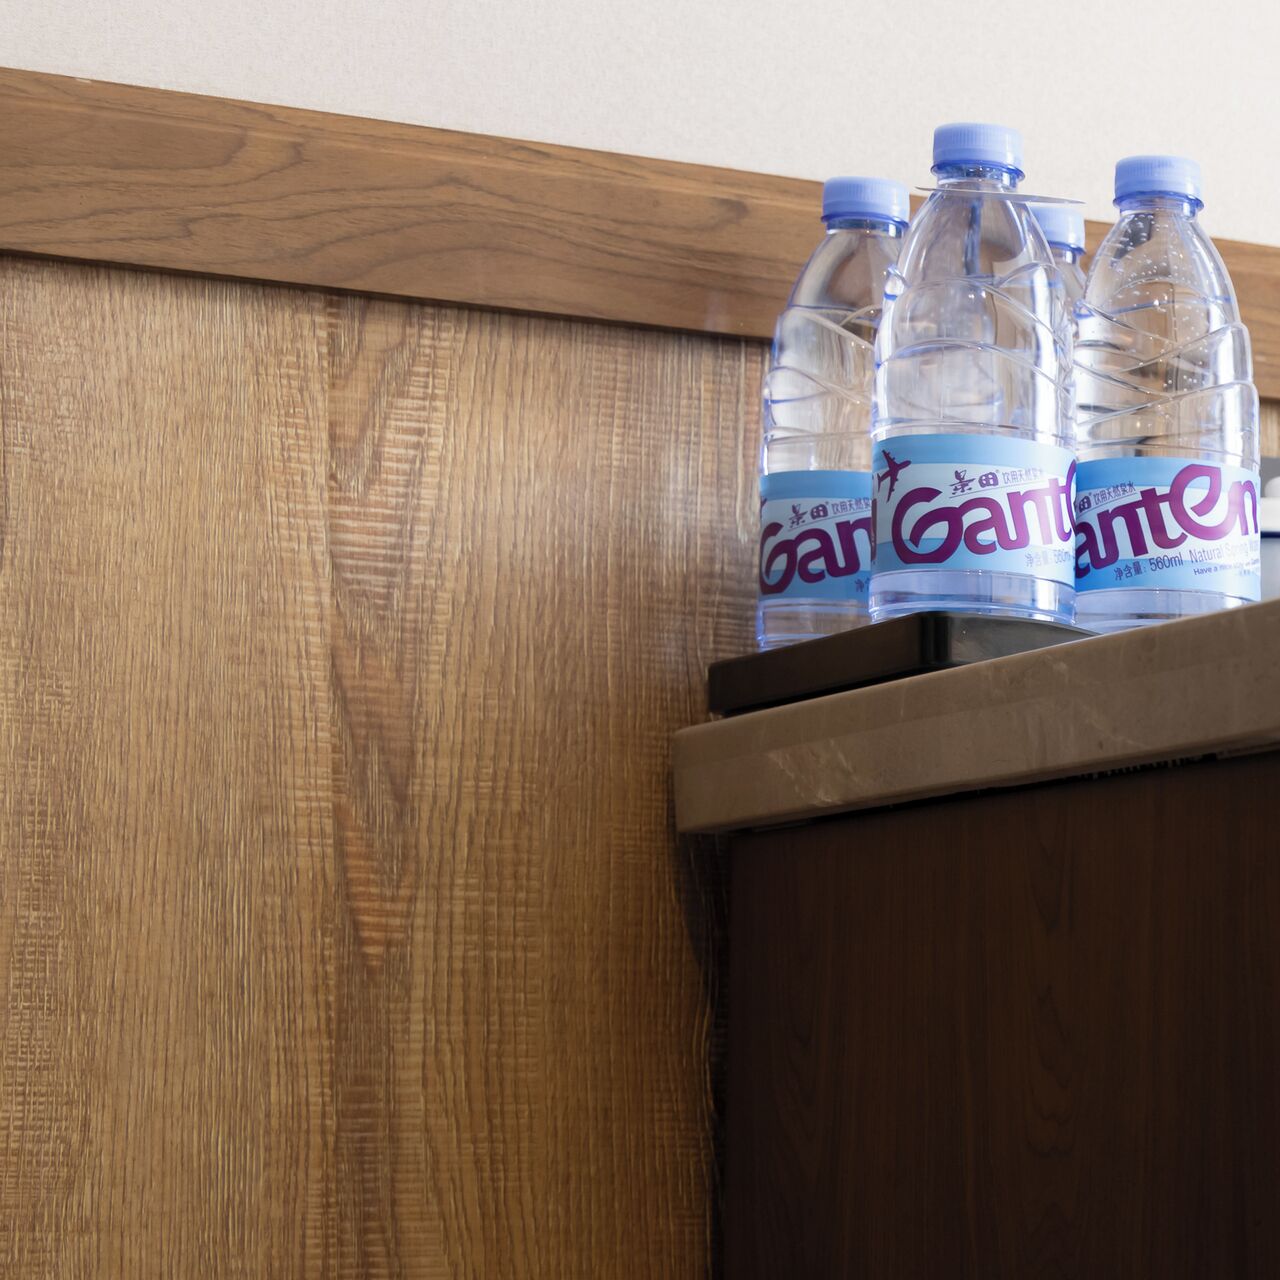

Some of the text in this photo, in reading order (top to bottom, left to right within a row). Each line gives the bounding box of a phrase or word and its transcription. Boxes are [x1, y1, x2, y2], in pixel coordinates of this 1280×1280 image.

[891, 459, 1076, 565] Gant
[1149, 552, 1184, 572] 560ml
[1188, 544, 1224, 564] Natural
